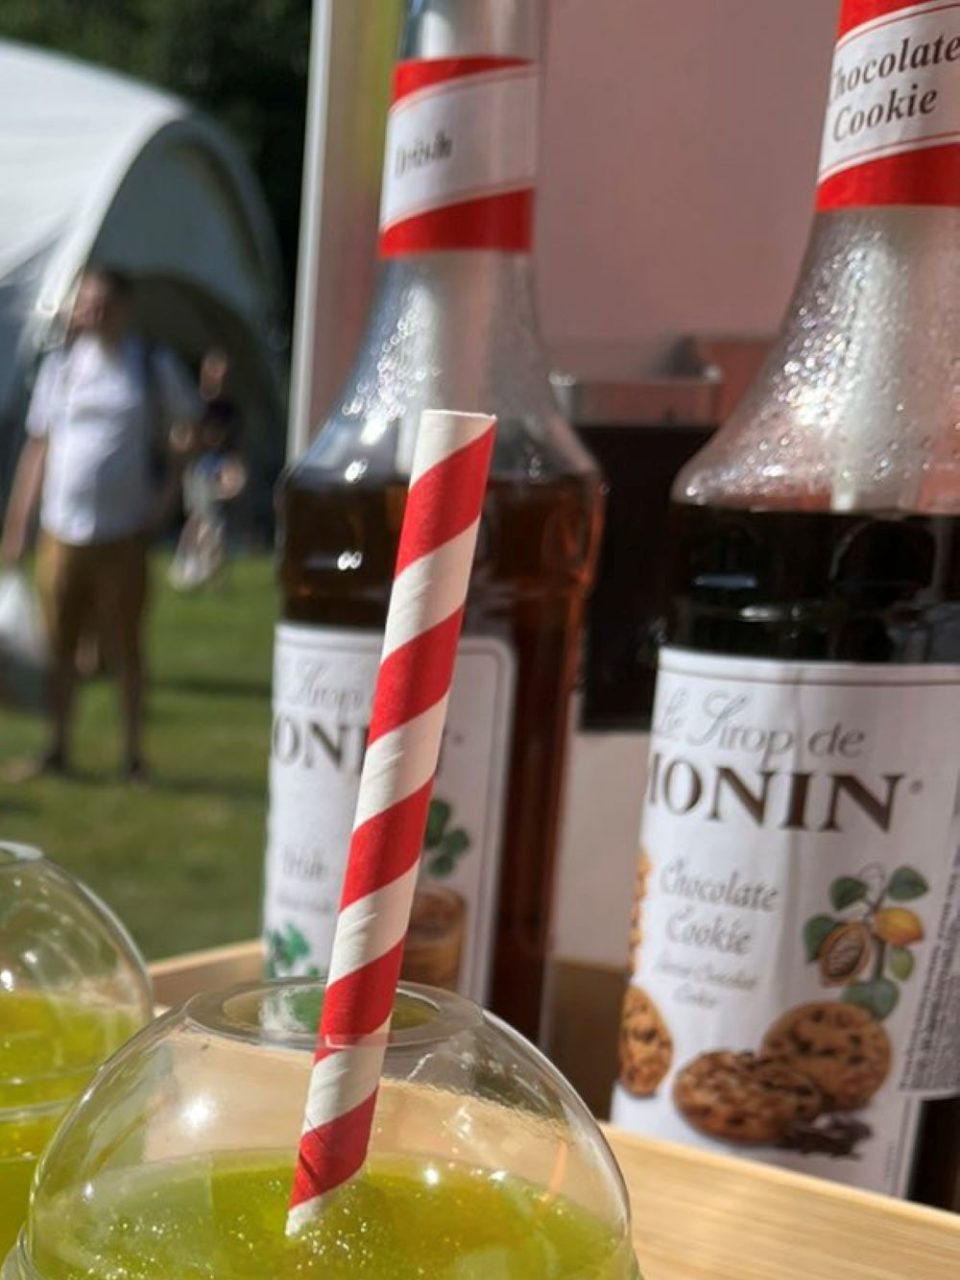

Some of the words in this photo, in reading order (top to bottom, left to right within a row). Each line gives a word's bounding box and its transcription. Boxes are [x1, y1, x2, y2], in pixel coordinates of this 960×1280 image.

[835, 34, 960, 98] hocolate
[833, 83, 938, 142] Cookie
[687, 689, 794, 771] Sirop
[807, 721, 866, 758] de
[649, 752, 906, 834] ONIN
[659, 858, 779, 913] Chocolate
[665, 903, 751, 956] Cookie
